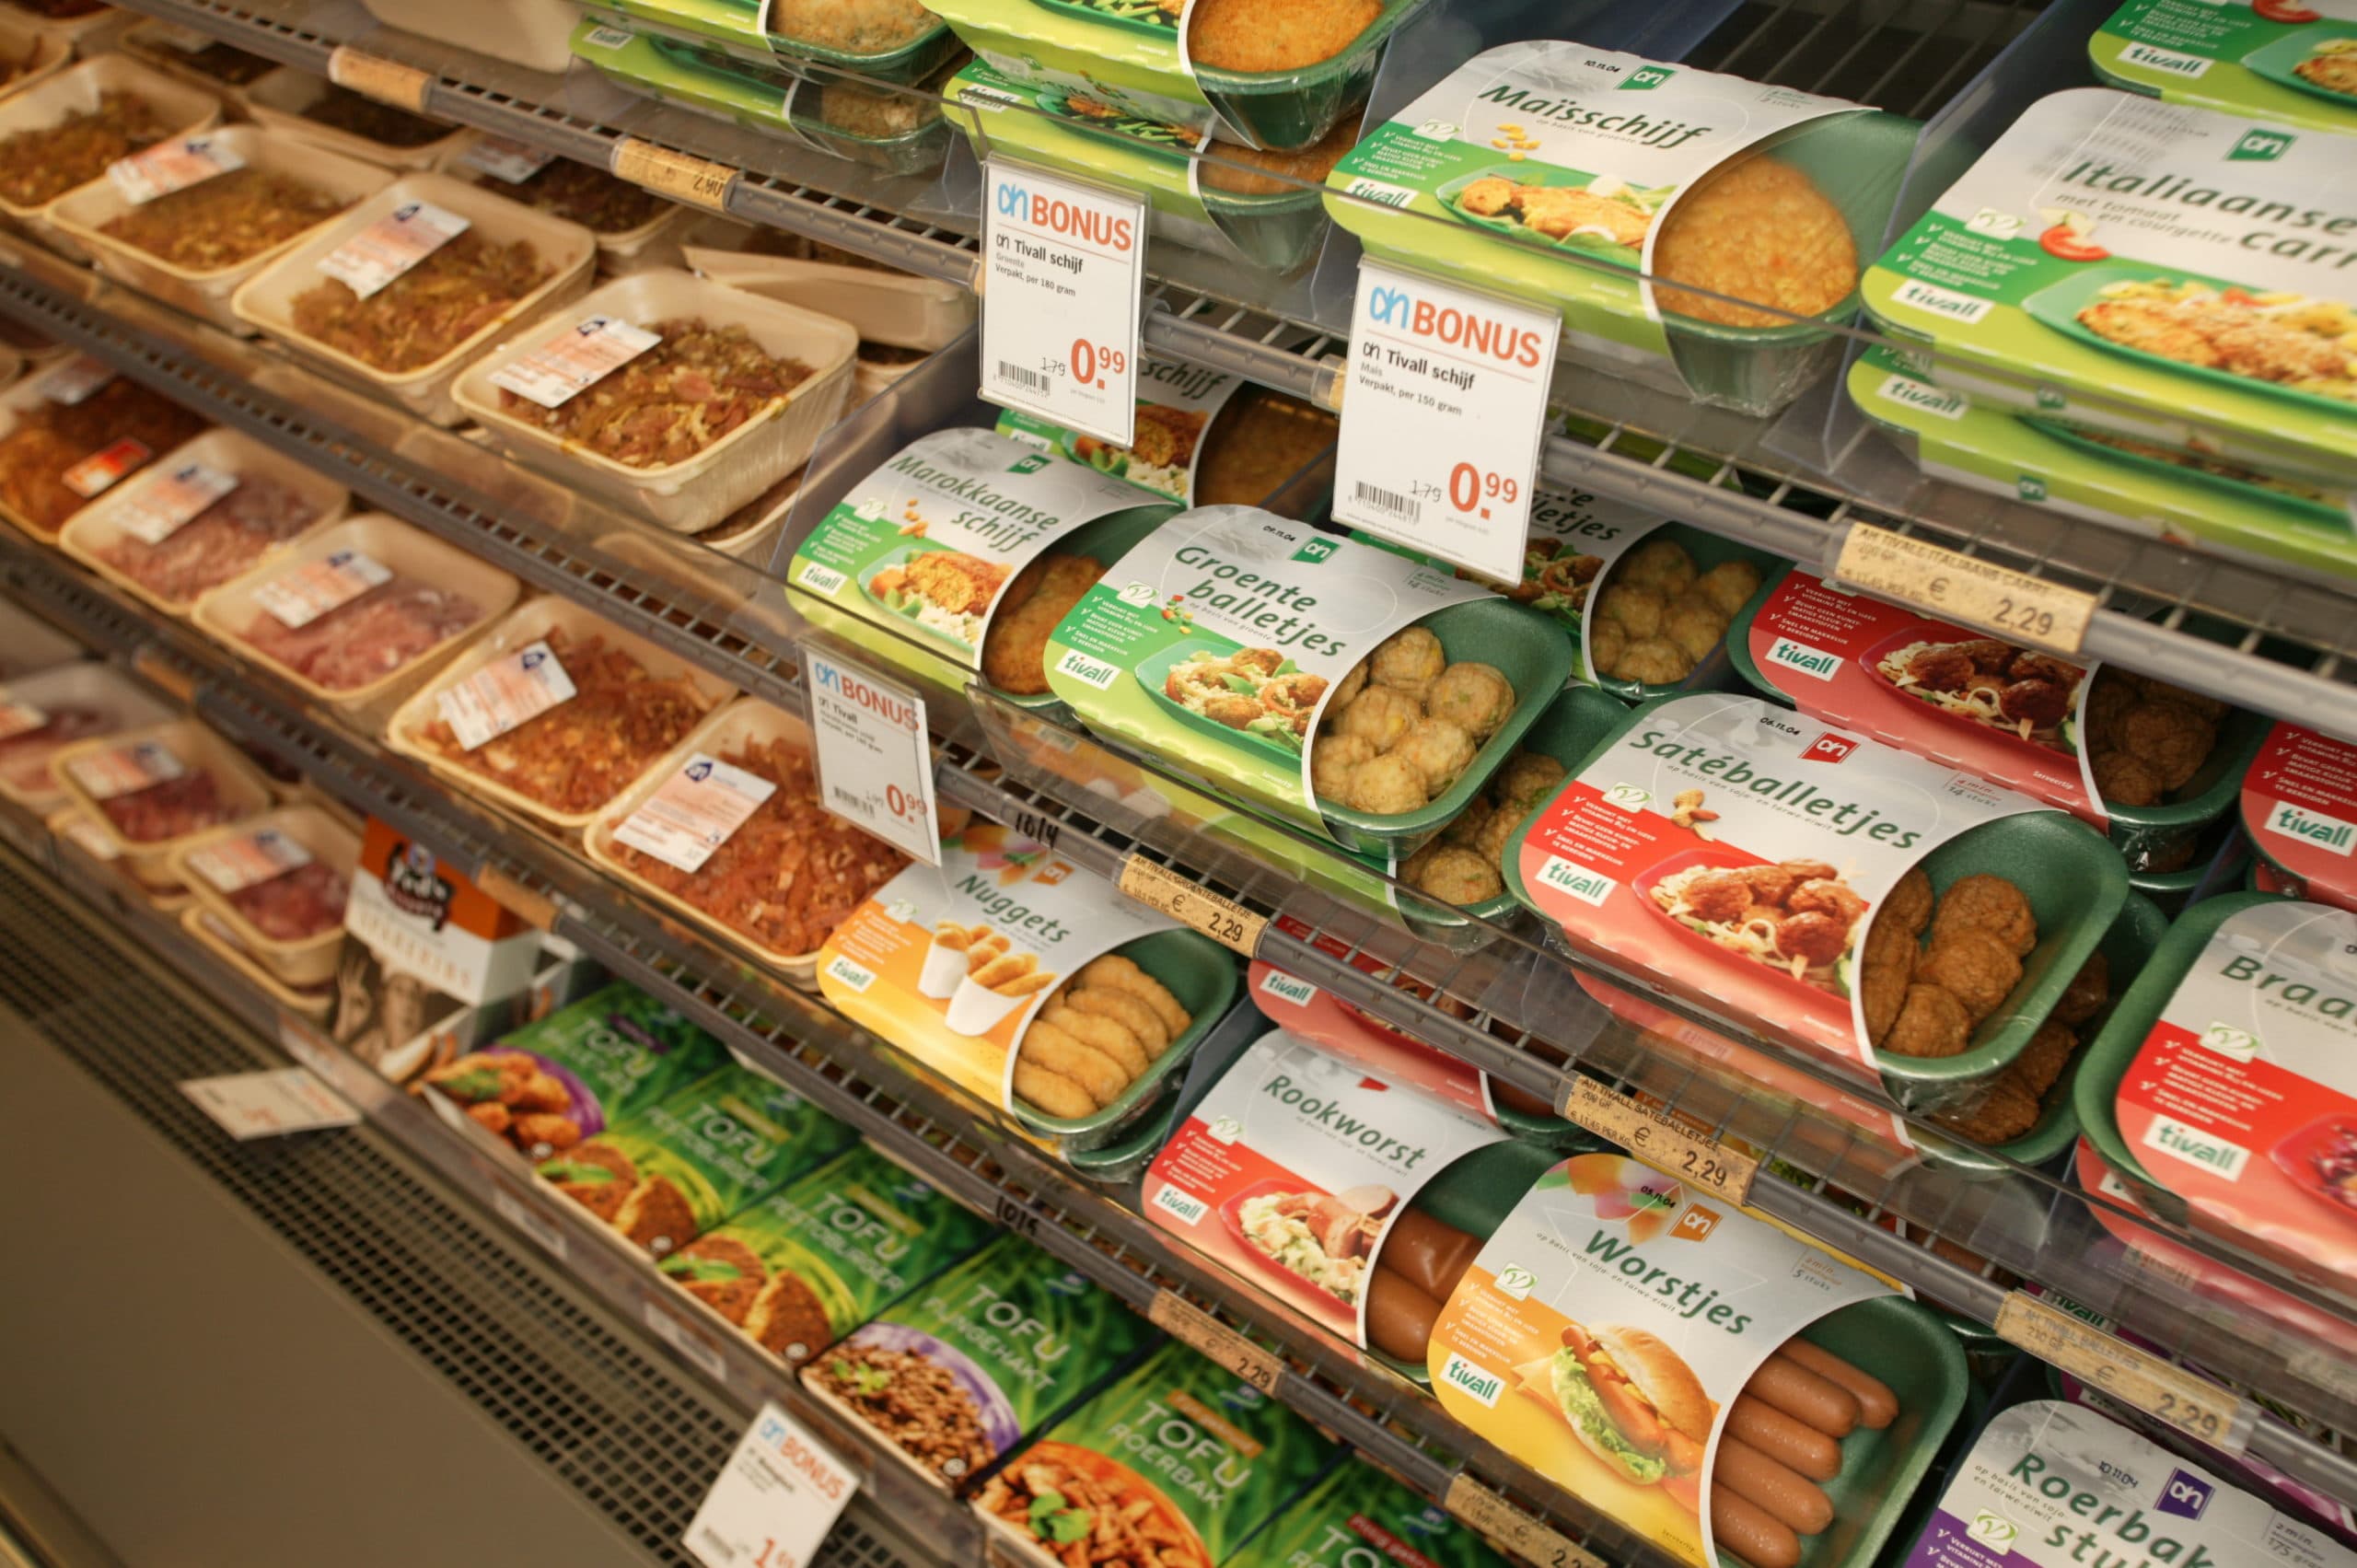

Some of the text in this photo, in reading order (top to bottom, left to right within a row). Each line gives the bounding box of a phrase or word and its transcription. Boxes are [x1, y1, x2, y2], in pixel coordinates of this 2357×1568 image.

[2131, 47, 2202, 74] tivall
[1479, 85, 1713, 148] Maïsschijf
[1032, 194, 1132, 250] BONUS
[2063, 162, 2357, 236] Italiaanse
[1015, 239, 1046, 261] Tivall
[1051, 252, 1084, 273] schijf
[1026, 275, 1039, 286] per
[1056, 282, 1076, 296] gram
[1905, 286, 1980, 317] tivall
[1412, 300, 1541, 368] BONUS
[1142, 360, 1227, 399] schijf
[1387, 350, 1429, 375] Tivall
[1433, 366, 1476, 390] schijf
[1399, 389, 1414, 402] per
[1417, 393, 1435, 408] 150
[1437, 400, 1462, 416] gram
[888, 455, 1060, 531] Marokkaanse
[951, 511, 1039, 552] schijf
[804, 567, 842, 590] tivall
[1175, 546, 1317, 612] Groente
[1186, 579, 1347, 656] balletjes
[1064, 656, 1113, 684] tivall
[1776, 644, 1836, 674] tivall
[841, 675, 920, 732] BONUS
[1629, 730, 1922, 849] Satéballetjes
[2279, 808, 2353, 848] tivall
[1548, 863, 1607, 899] tivall
[956, 875, 1072, 942] Nuggets
[1172, 894, 1244, 943] € 2,29
[1269, 974, 1311, 1002] tivall
[2220, 955, 2357, 1024] Braa
[691, 1102, 778, 1167] TOFU
[1262, 1074, 1426, 1170] Rookworst
[2159, 1123, 2236, 1170] tivall
[1634, 1127, 1726, 1187] € 2,29
[813, 1192, 911, 1262] TOFU
[1161, 1190, 1202, 1219] tivall
[1585, 1229, 1753, 1334] Worstjes
[968, 1284, 1071, 1363] TOFU
[1449, 1361, 1498, 1400] tivall
[781, 1436, 846, 1500] BONUS
[1109, 1423, 1225, 1510] ROERBAK
[1136, 1400, 1252, 1490] TOFU
[1974, 1476, 1987, 1485] en
[1975, 1465, 2039, 1504] op basis van
[2268, 1538, 2291, 1557] 175
